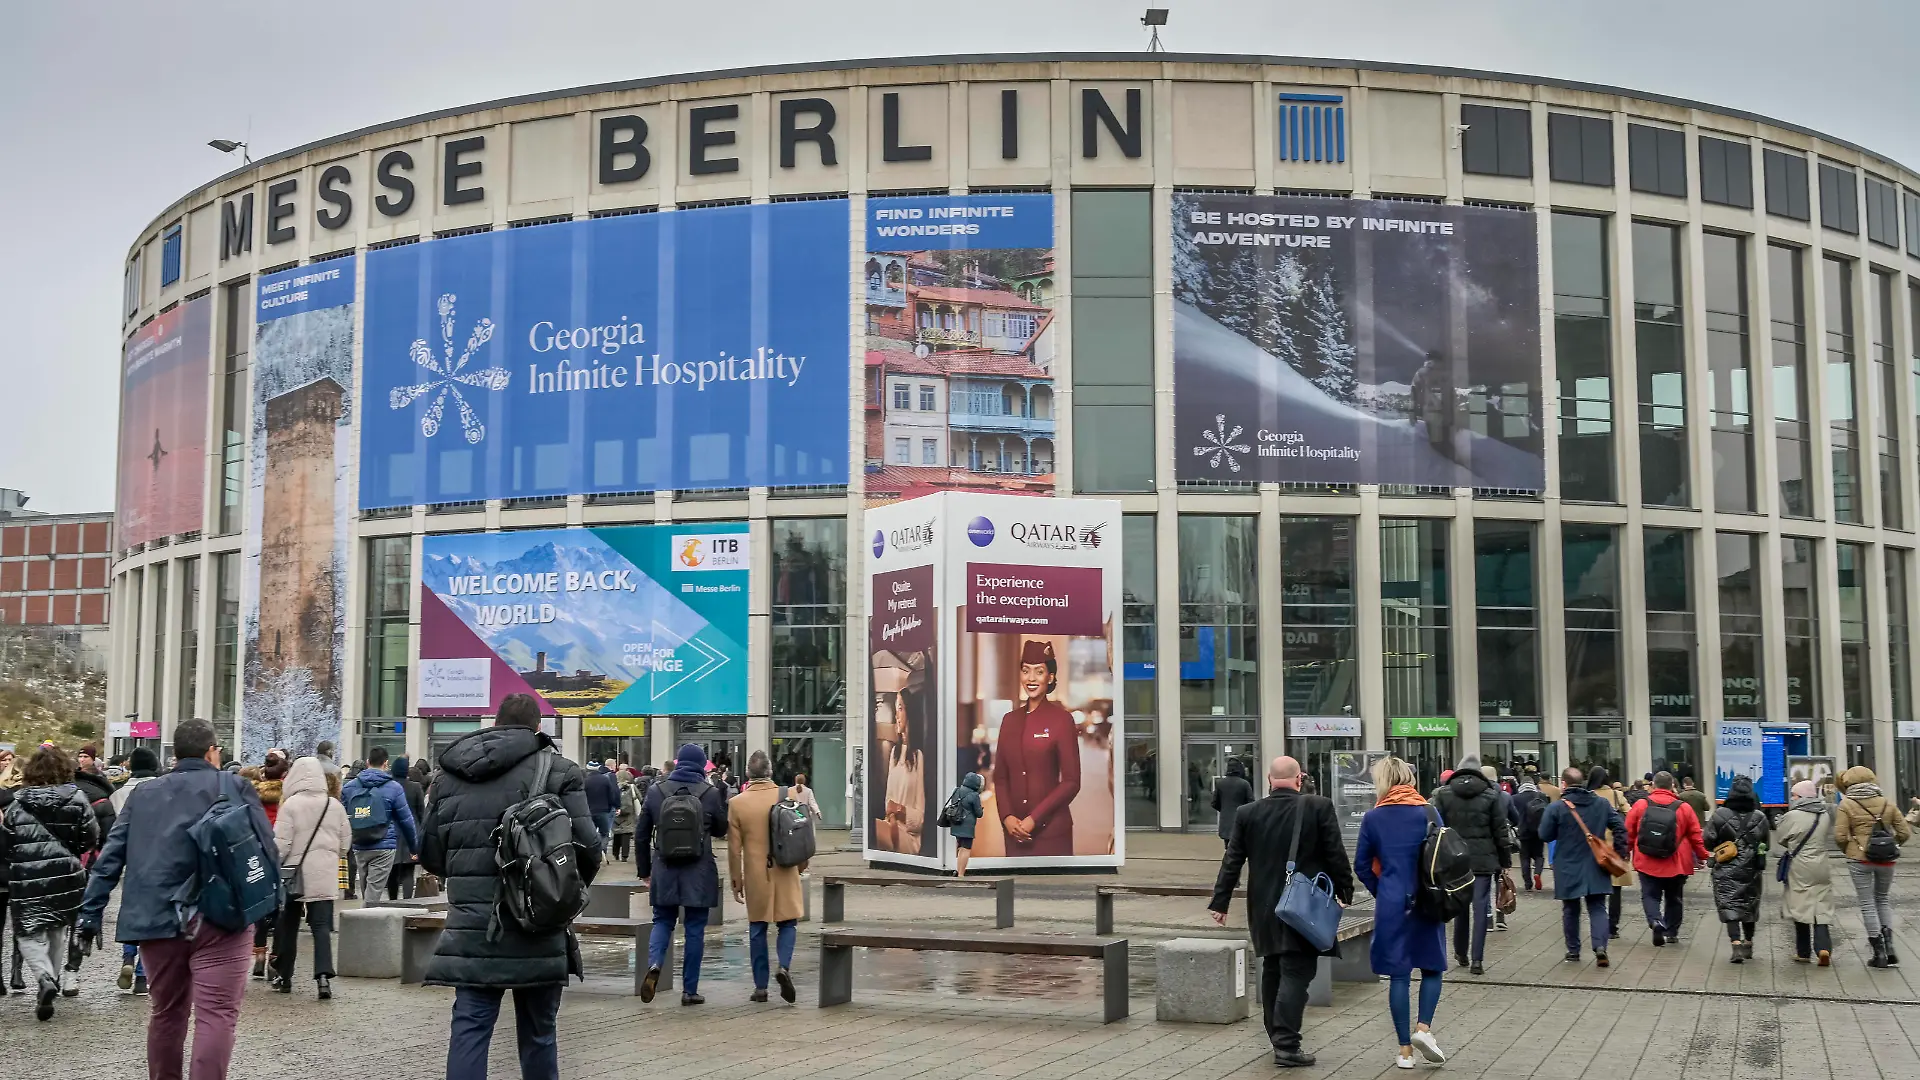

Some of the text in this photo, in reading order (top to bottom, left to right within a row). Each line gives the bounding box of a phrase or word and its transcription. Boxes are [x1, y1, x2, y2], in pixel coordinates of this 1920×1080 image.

[220, 87, 1142, 261] MESSE BERLIN
[876, 206, 1014, 220] FIND INFINITE
[877, 224, 980, 237] WONDERS
[1191, 211, 1454, 235] BE HOSTED BY INFINITE
[1192, 231, 1331, 248] ADVENTURE
[262, 268, 341, 295] MEET INFINITE
[261, 290, 309, 310] CULTURE
[528, 315, 646, 355] Georgia
[529, 346, 807, 394] Infinite Hospitality
[1257, 429, 1304, 445] Georgia
[1257, 444, 1361, 462] Infinite Hospitality
[890, 525, 921, 550] QATAR
[1011, 522, 1077, 543] QATAR
[713, 539, 738, 554] ITB
[1026, 542, 1055, 550] AIRWAYS
[712, 556, 739, 566] BERLIN
[448, 570, 638, 596] WELCOME BACK,
[695, 584, 741, 593] Messe Berlin
[976, 574, 1044, 590] Experience
[887, 599, 898, 613] My
[976, 591, 1069, 609] the exceptional
[476, 603, 558, 626] WORLD
[975, 615, 1049, 626] qatarairways.com
[622, 642, 675, 659] OPEN FOR
